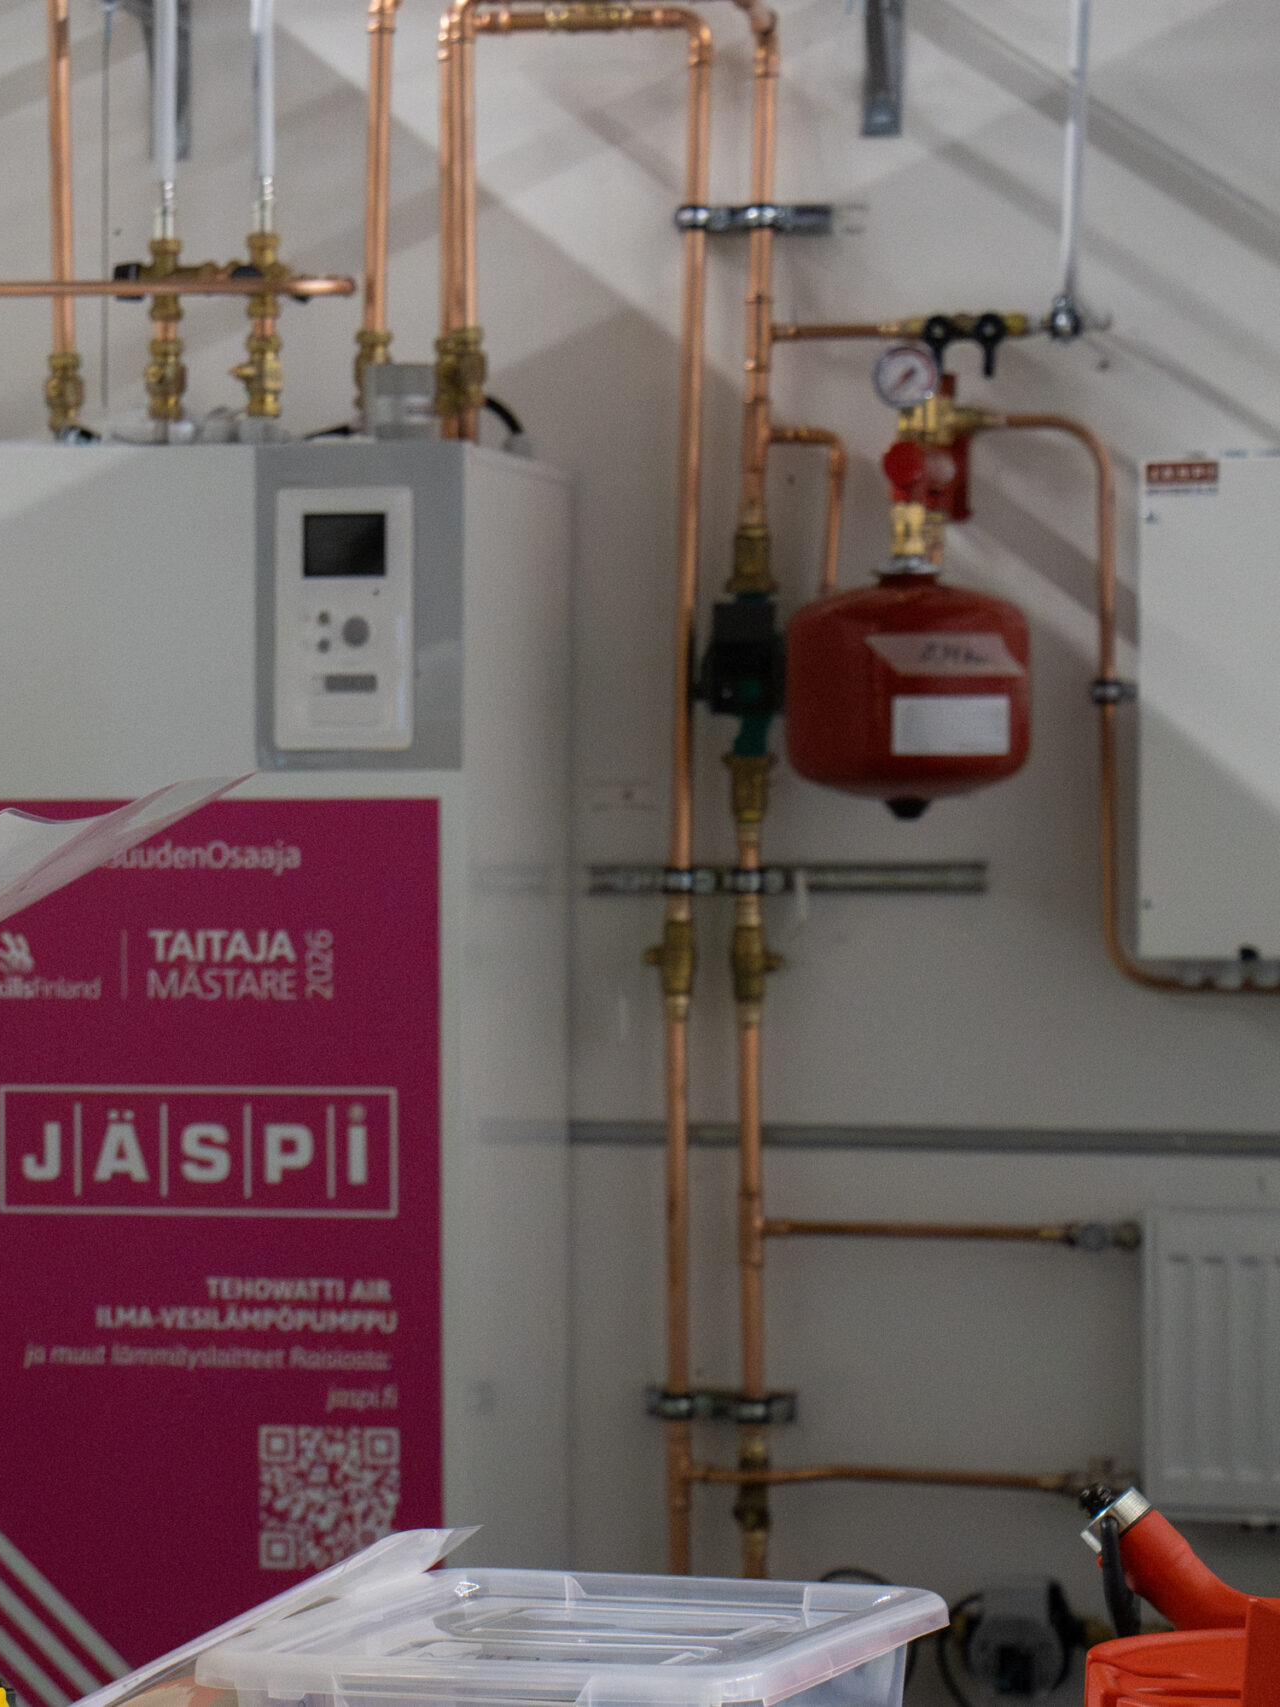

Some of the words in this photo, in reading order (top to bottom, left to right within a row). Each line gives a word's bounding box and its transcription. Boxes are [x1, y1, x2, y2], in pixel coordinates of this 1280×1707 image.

[103, 838, 303, 876] suudenOsaaja
[147, 929, 297, 964] TAITAJA
[305, 928, 335, 1001] 2026
[146, 965, 298, 1001] MÄSTARE
[206, 1276, 346, 1302] TEHOWATTI
[351, 1278, 392, 1303] AIR
